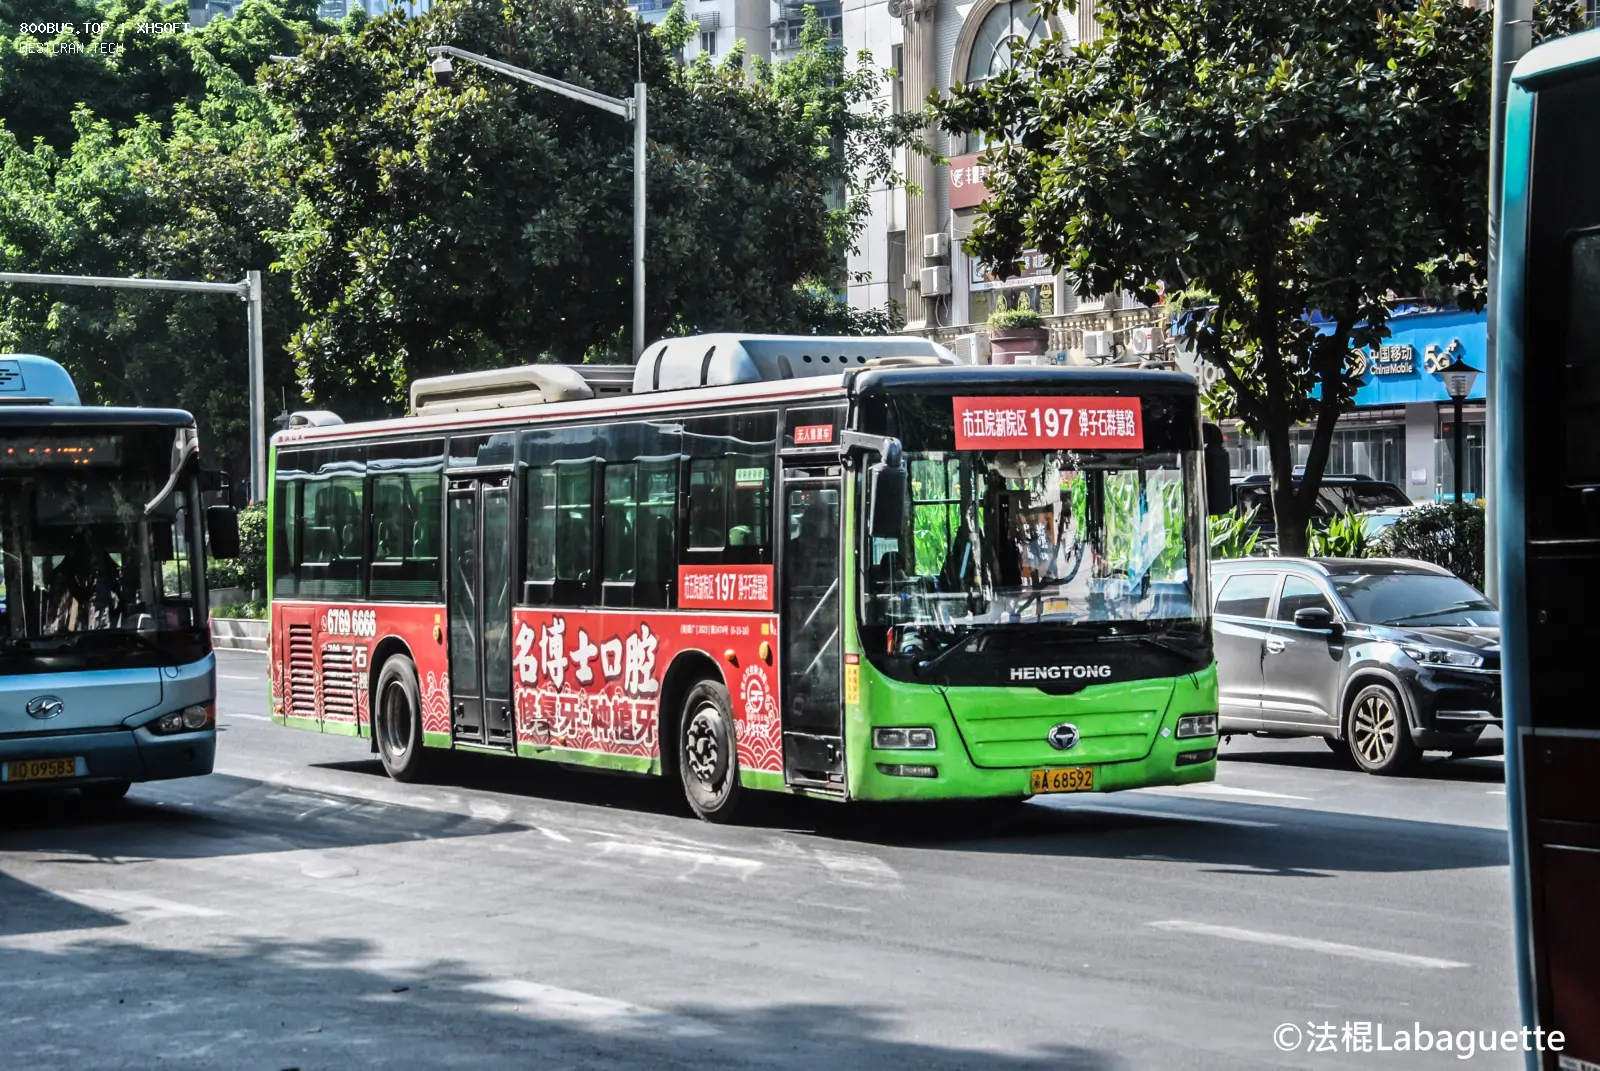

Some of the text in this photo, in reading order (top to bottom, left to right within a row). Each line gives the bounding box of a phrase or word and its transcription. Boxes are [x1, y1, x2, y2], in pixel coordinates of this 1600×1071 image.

[1369, 345, 1412, 362] 中国移动
[962, 408, 1136, 437] 市五院新院区 197 弹子石群慧路
[715, 573, 737, 600] 197
[327, 608, 376, 637] 6769 6666
[514, 617, 659, 694] 名博士口腔
[1010, 665, 1111, 680] HENGTONG
